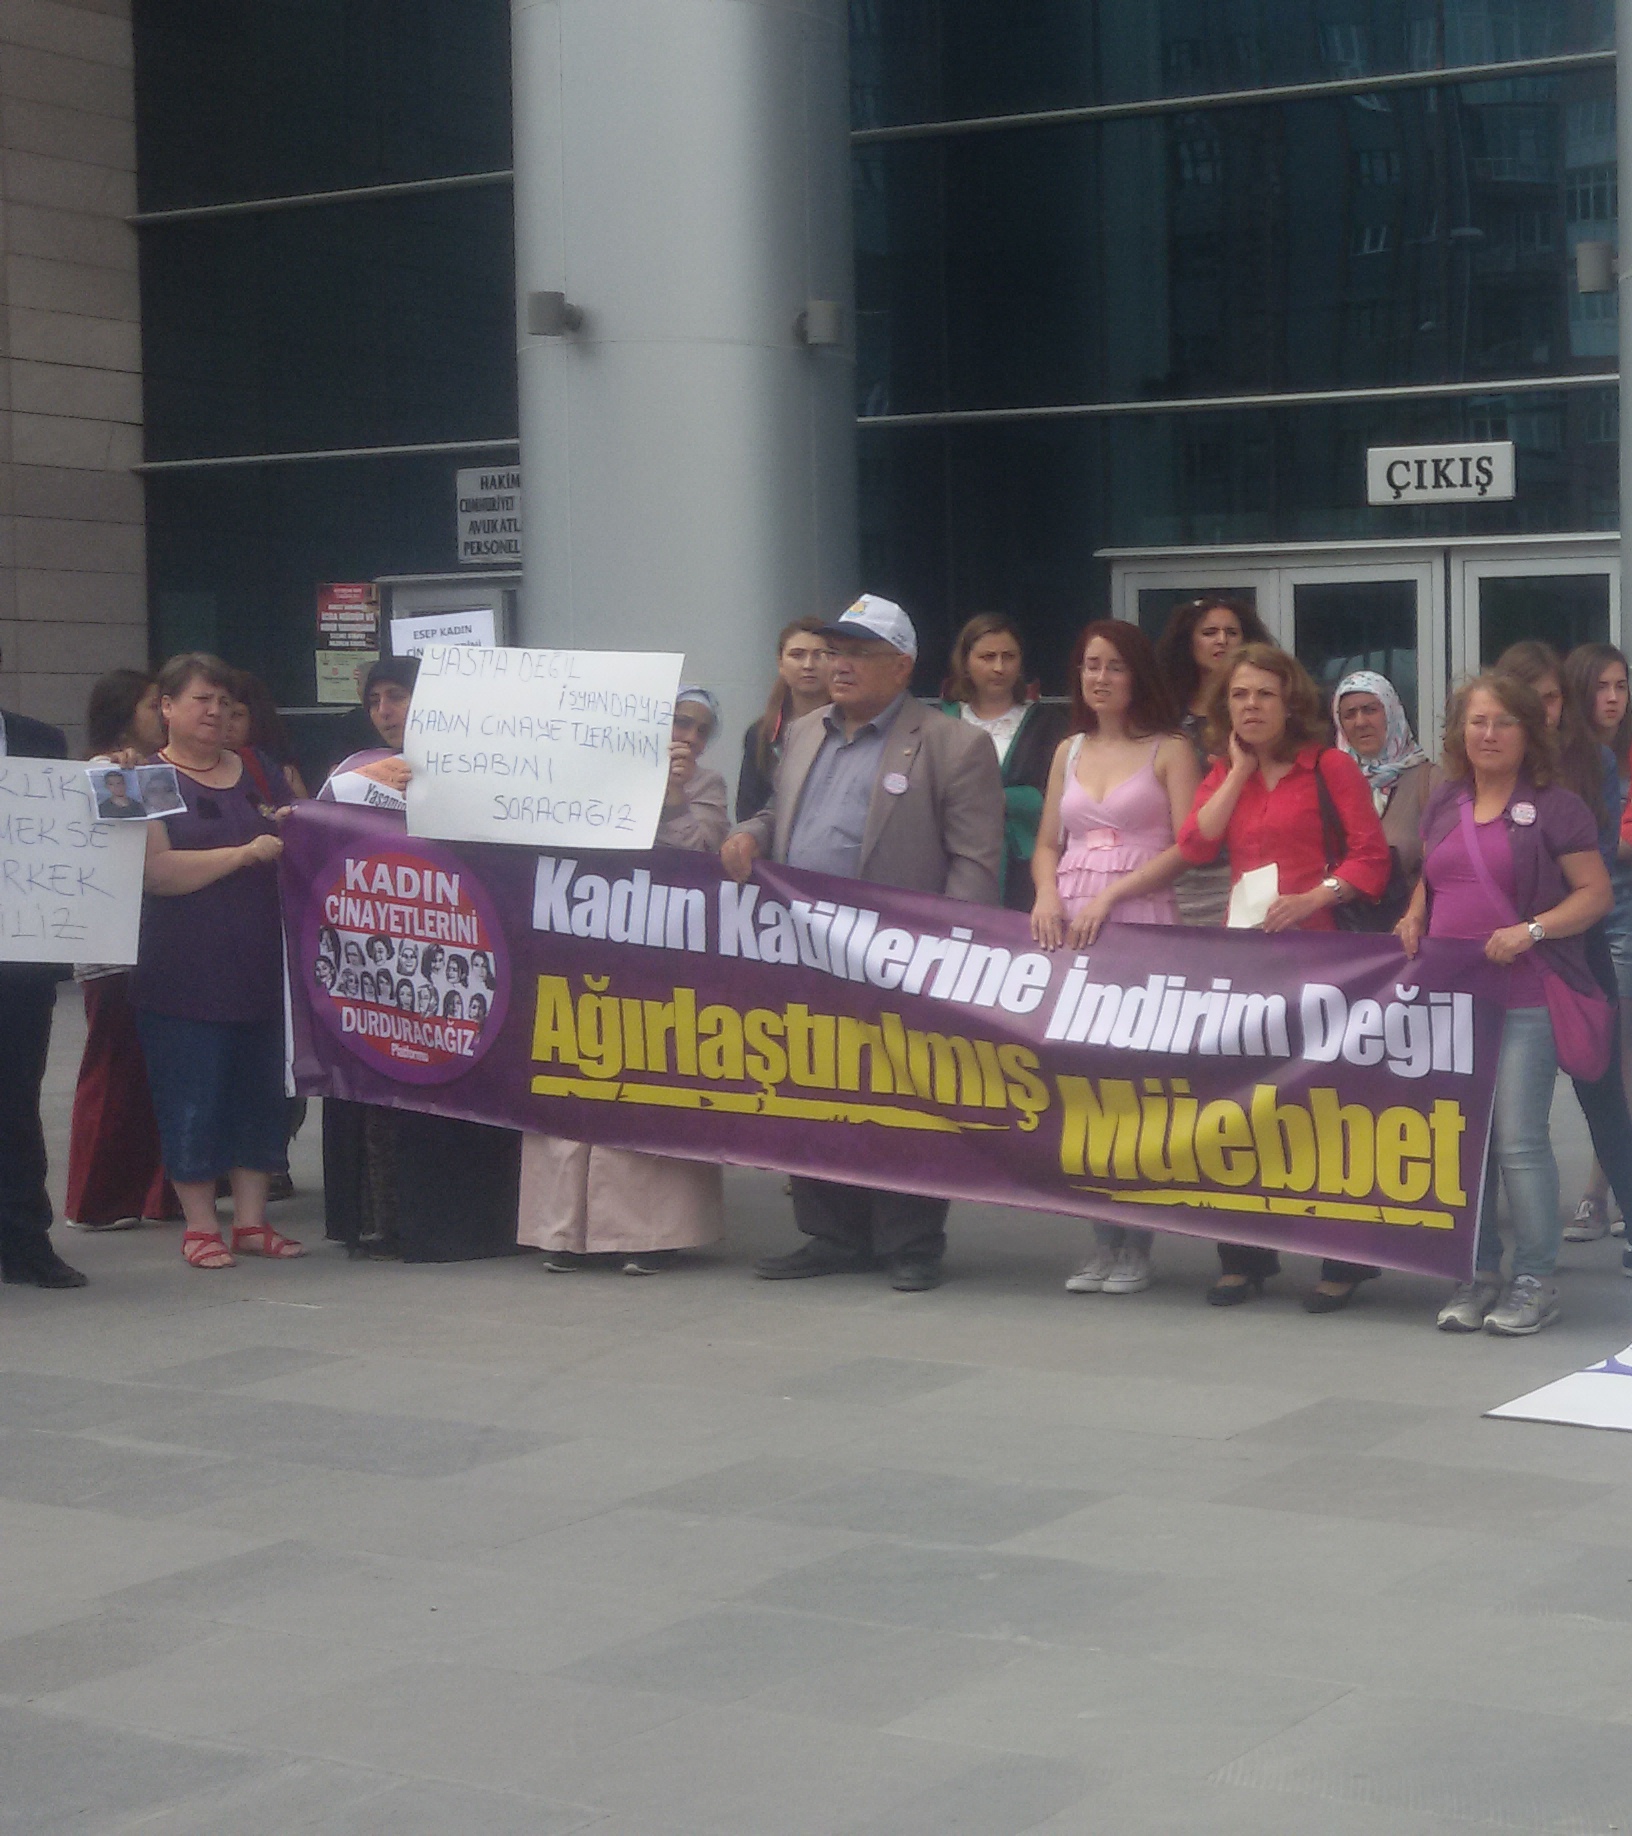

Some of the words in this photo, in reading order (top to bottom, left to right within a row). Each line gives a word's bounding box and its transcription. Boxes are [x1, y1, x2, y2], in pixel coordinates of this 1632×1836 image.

[1386, 456, 1493, 499] ÇIKIŞ
[440, 625, 472, 637] KADIN
[409, 708, 470, 739] KADIN
[426, 750, 553, 785] HESABINI
[493, 794, 637, 832] SORACAĞIZ
[345, 858, 460, 906] KADIN
[325, 890, 479, 945] CİNAYETLERİNİ
[532, 855, 706, 953] Kadın
[717, 880, 1053, 1013] Katillerine
[1045, 956, 1291, 1058] İndirim
[1303, 983, 1475, 1079] Değil
[341, 1006, 475, 1057] DURDURACAĞIZ
[531, 973, 1050, 1132] Ağırlaştırılmış
[1055, 1075, 1467, 1207] Müebbet
